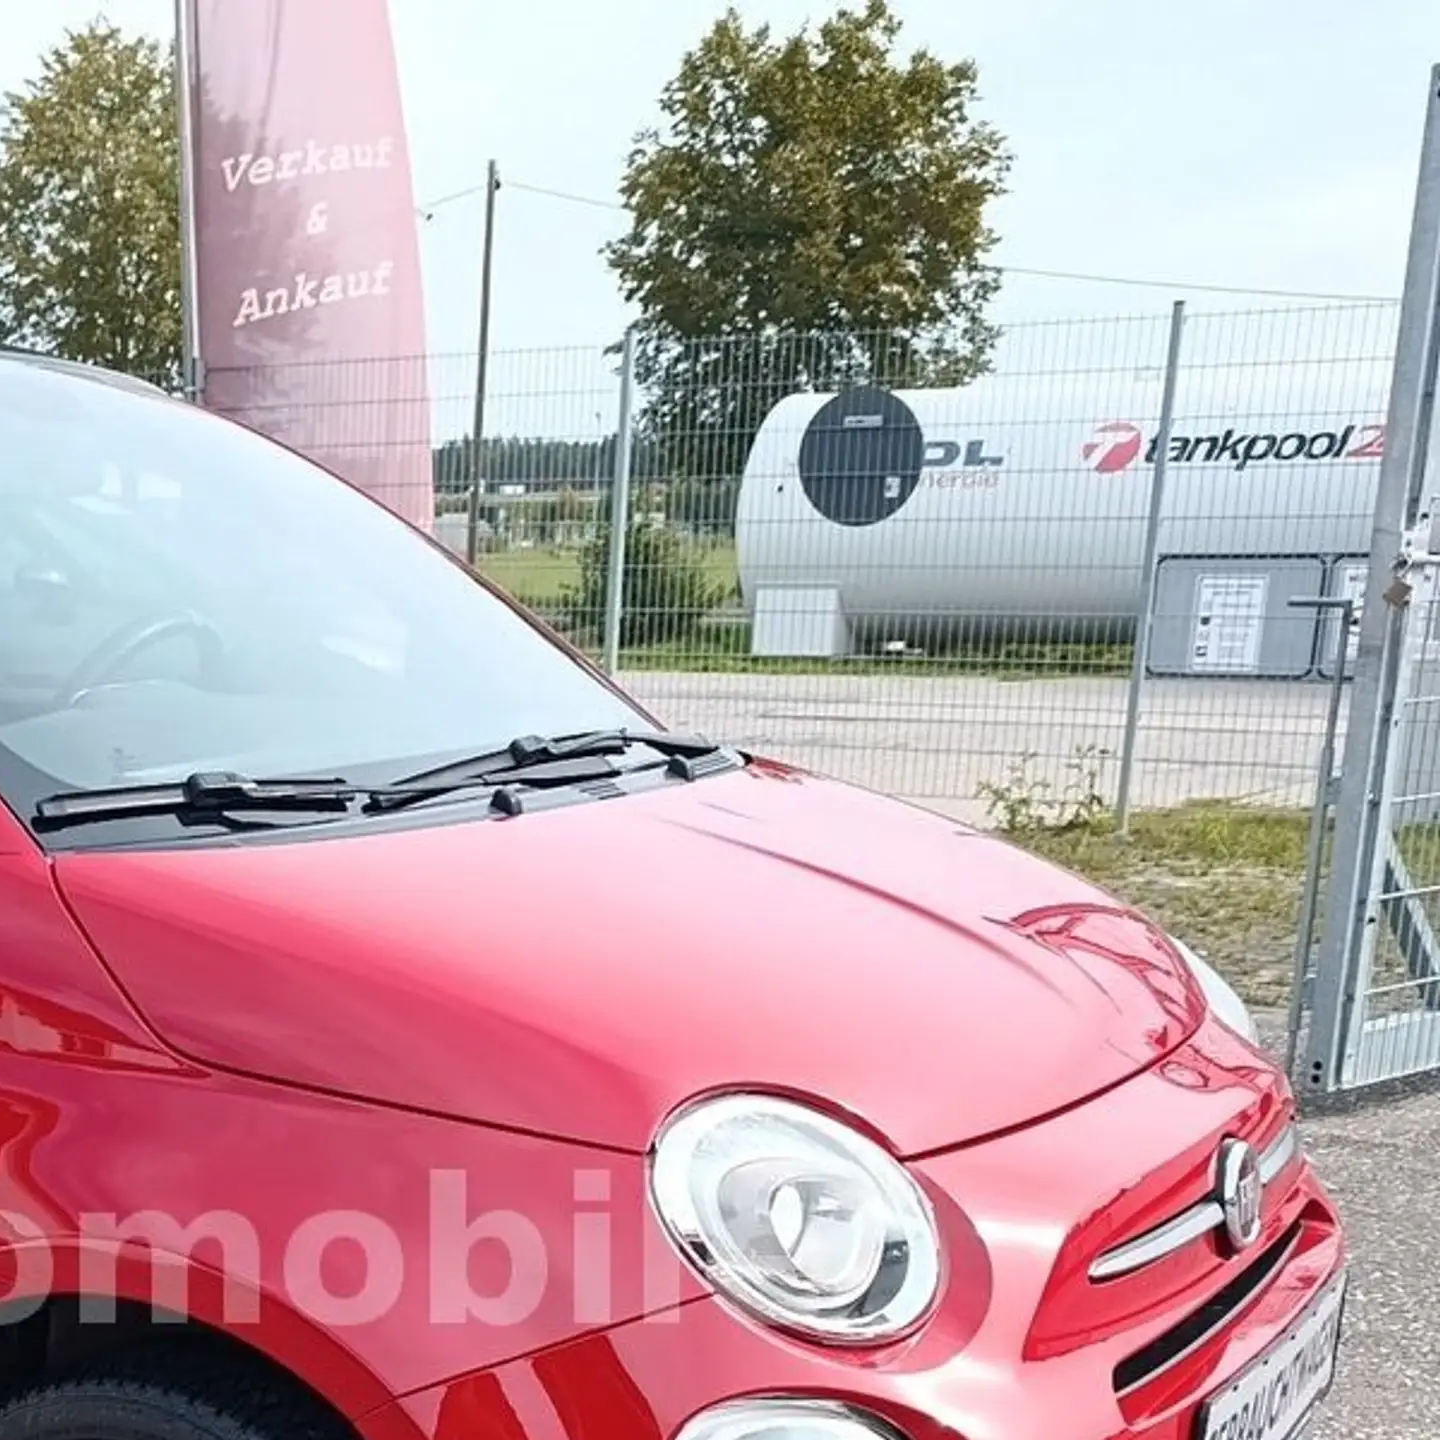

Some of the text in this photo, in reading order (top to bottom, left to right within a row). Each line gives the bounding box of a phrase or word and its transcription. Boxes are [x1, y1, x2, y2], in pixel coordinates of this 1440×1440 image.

[221, 137, 395, 193] Verkauf
[307, 202, 328, 235] &
[232, 260, 395, 328] Ankauf
[921, 439, 1004, 467] DL
[1144, 424, 1384, 471] tankpool2
